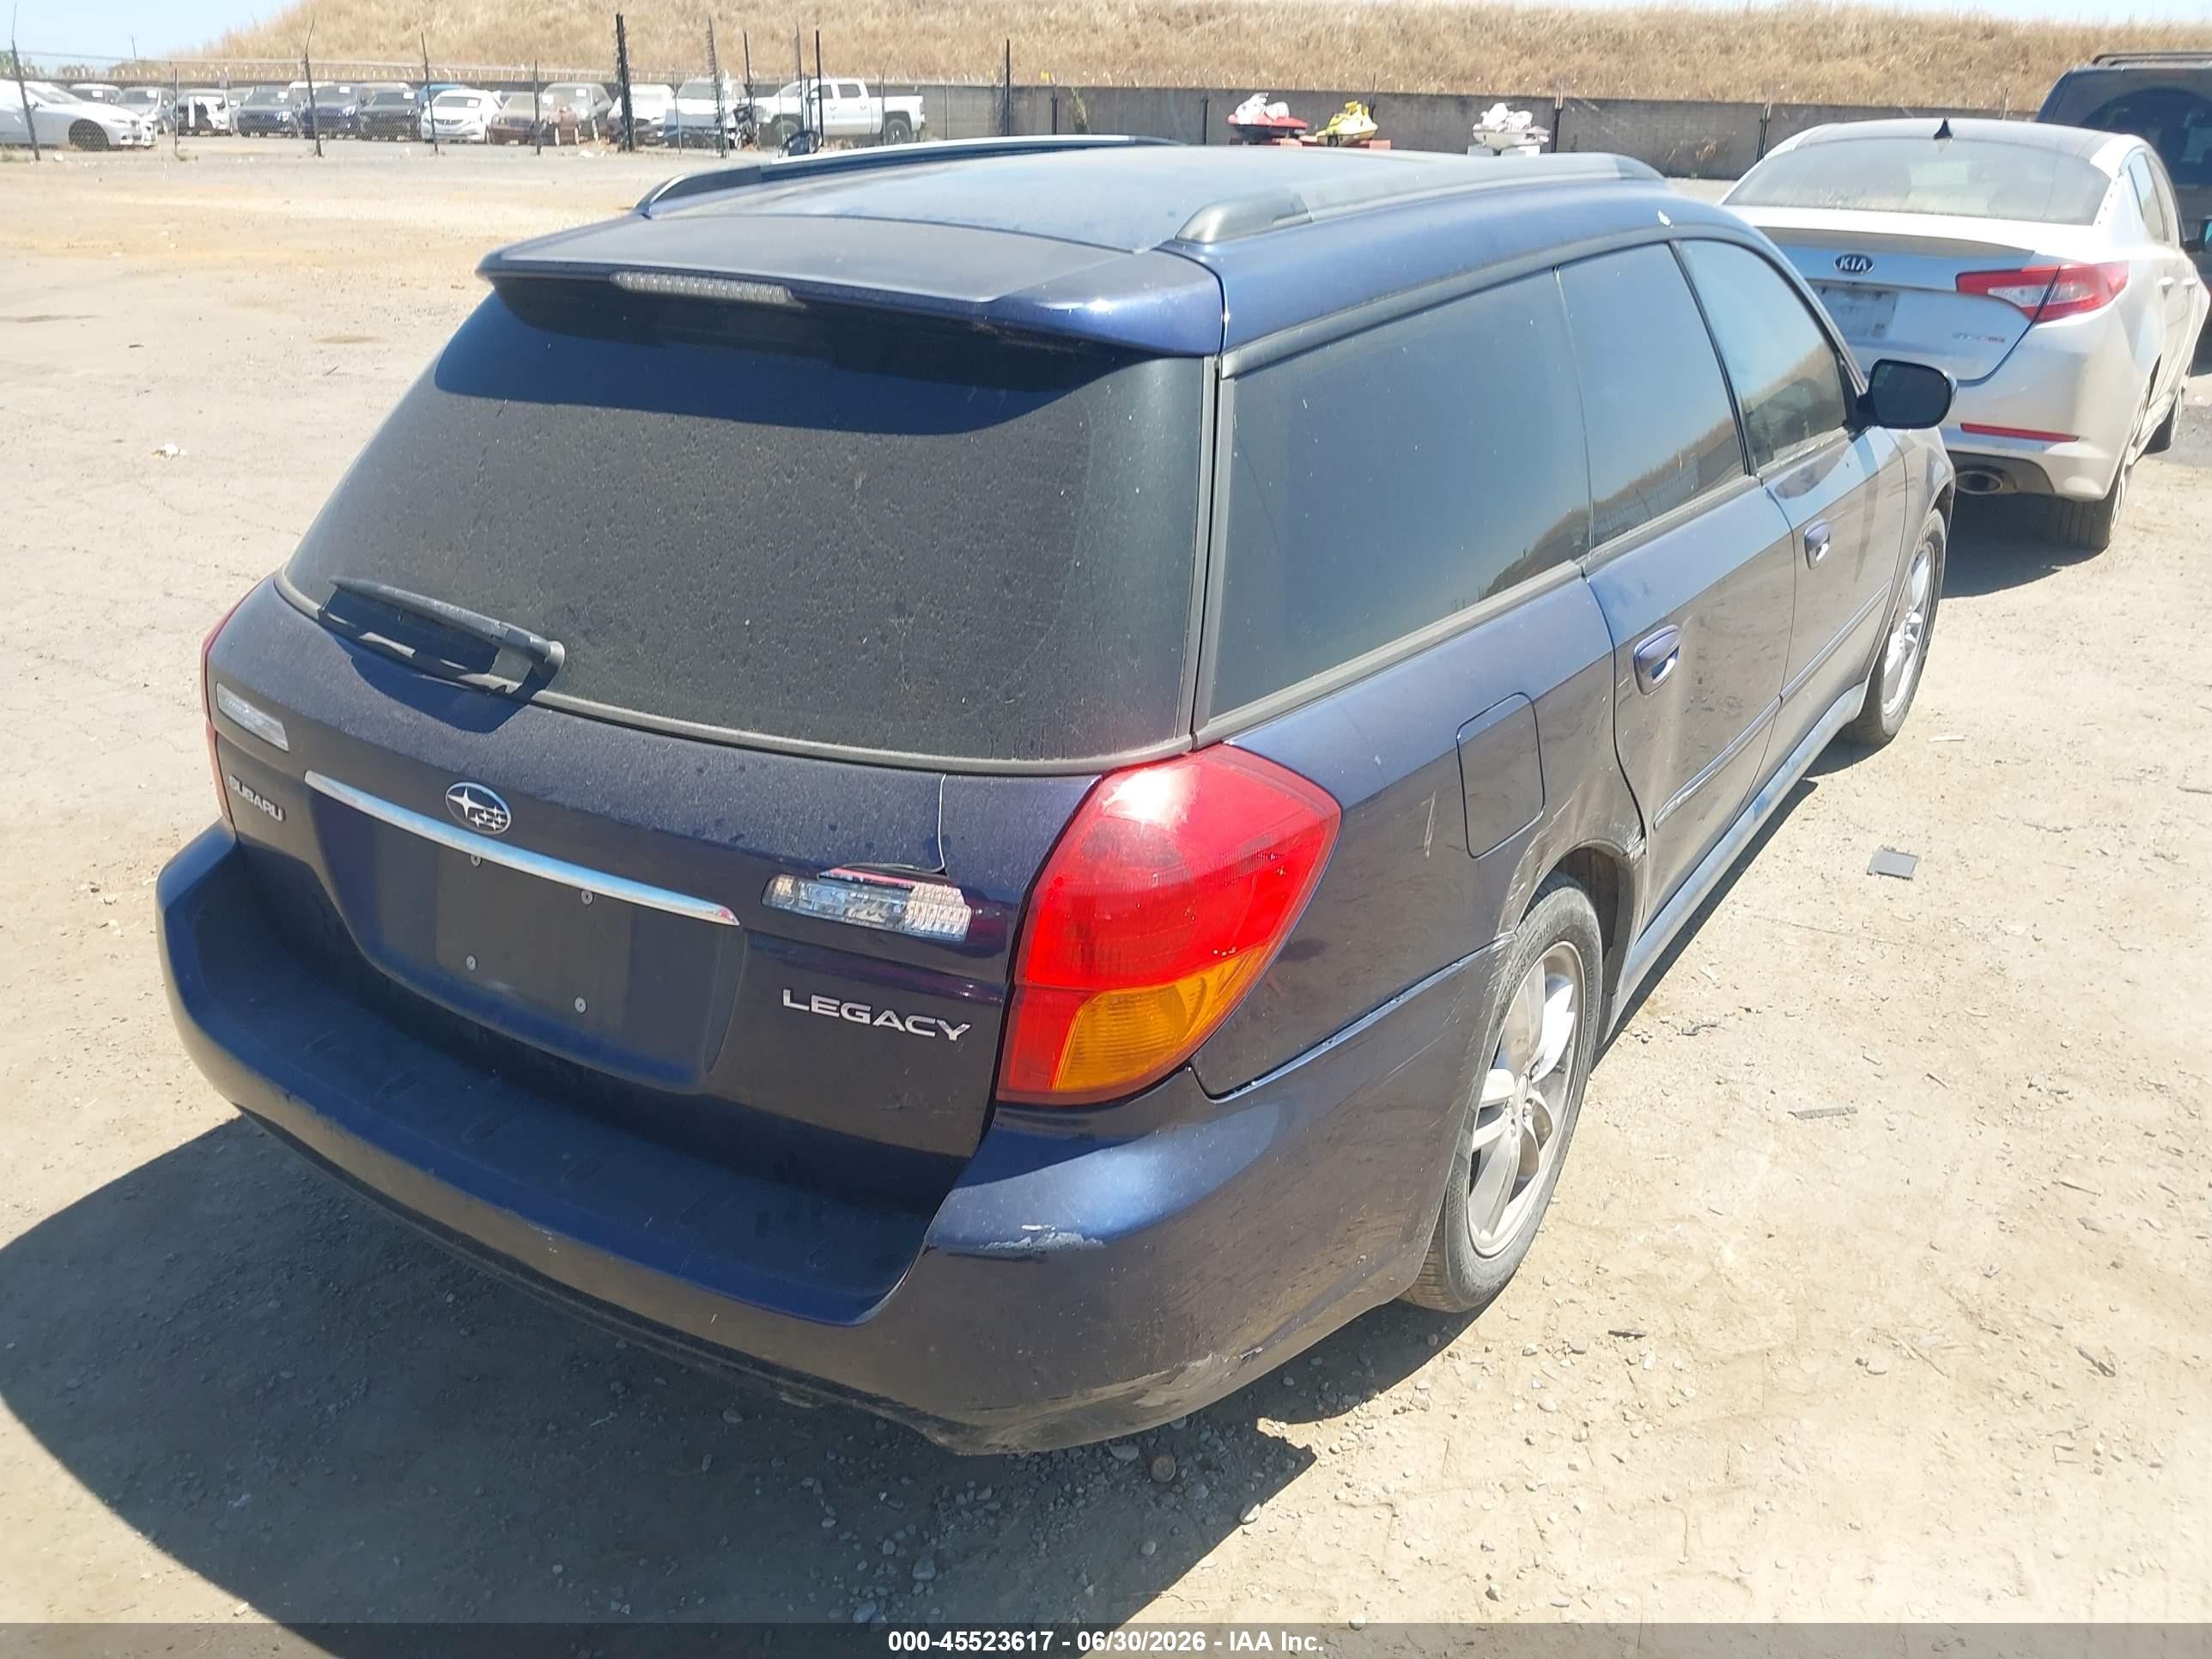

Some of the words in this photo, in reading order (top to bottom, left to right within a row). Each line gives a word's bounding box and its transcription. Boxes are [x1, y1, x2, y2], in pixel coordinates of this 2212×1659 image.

[1839, 256, 1868, 270] KIA
[228, 775, 284, 822] SUBARU
[782, 988, 972, 1042] LEGACY
